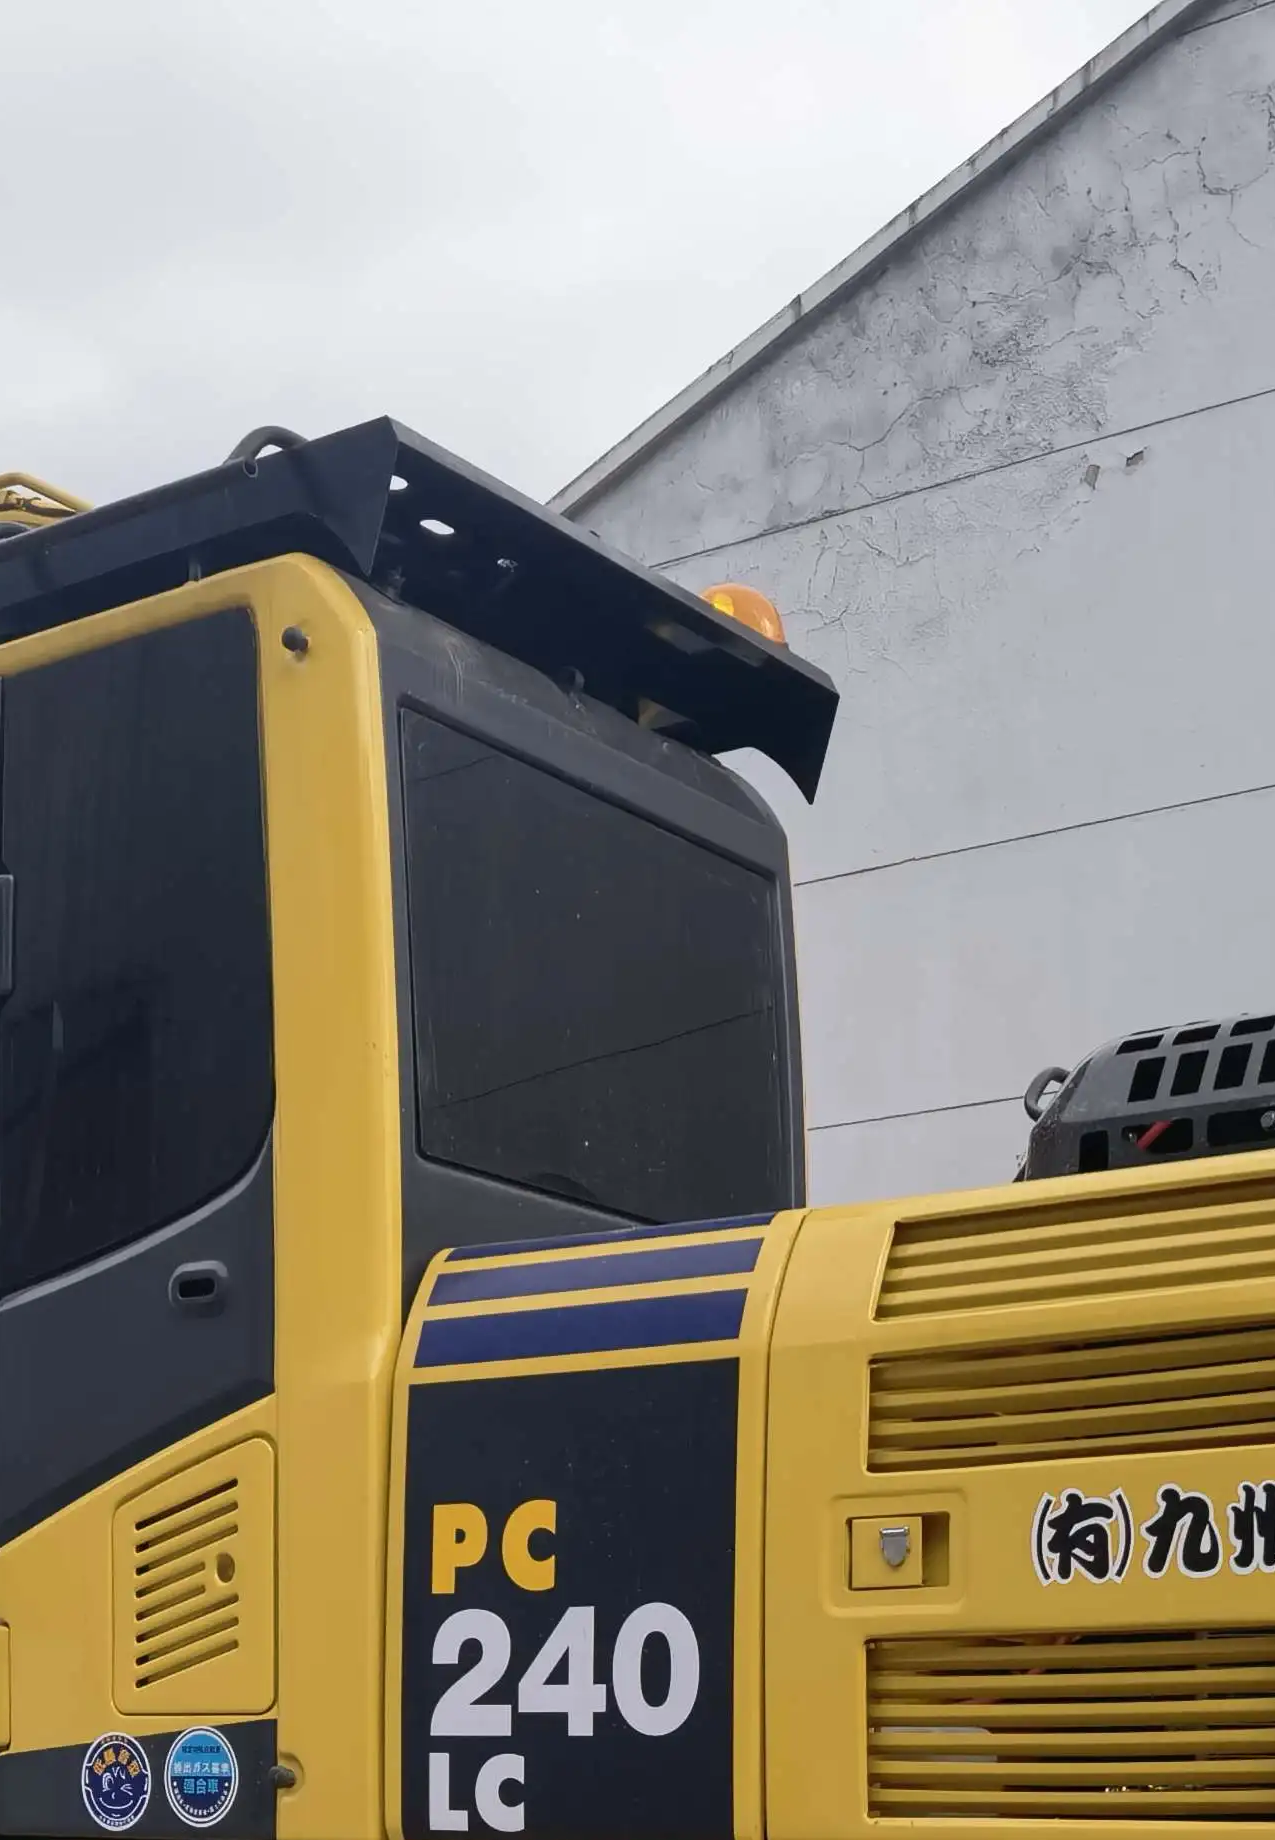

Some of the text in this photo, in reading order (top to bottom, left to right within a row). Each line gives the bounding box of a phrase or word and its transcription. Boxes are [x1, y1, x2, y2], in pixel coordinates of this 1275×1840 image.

[431, 1499, 557, 1594] PC
[430, 1602, 700, 1737] 240
[429, 1752, 525, 1833] LC
